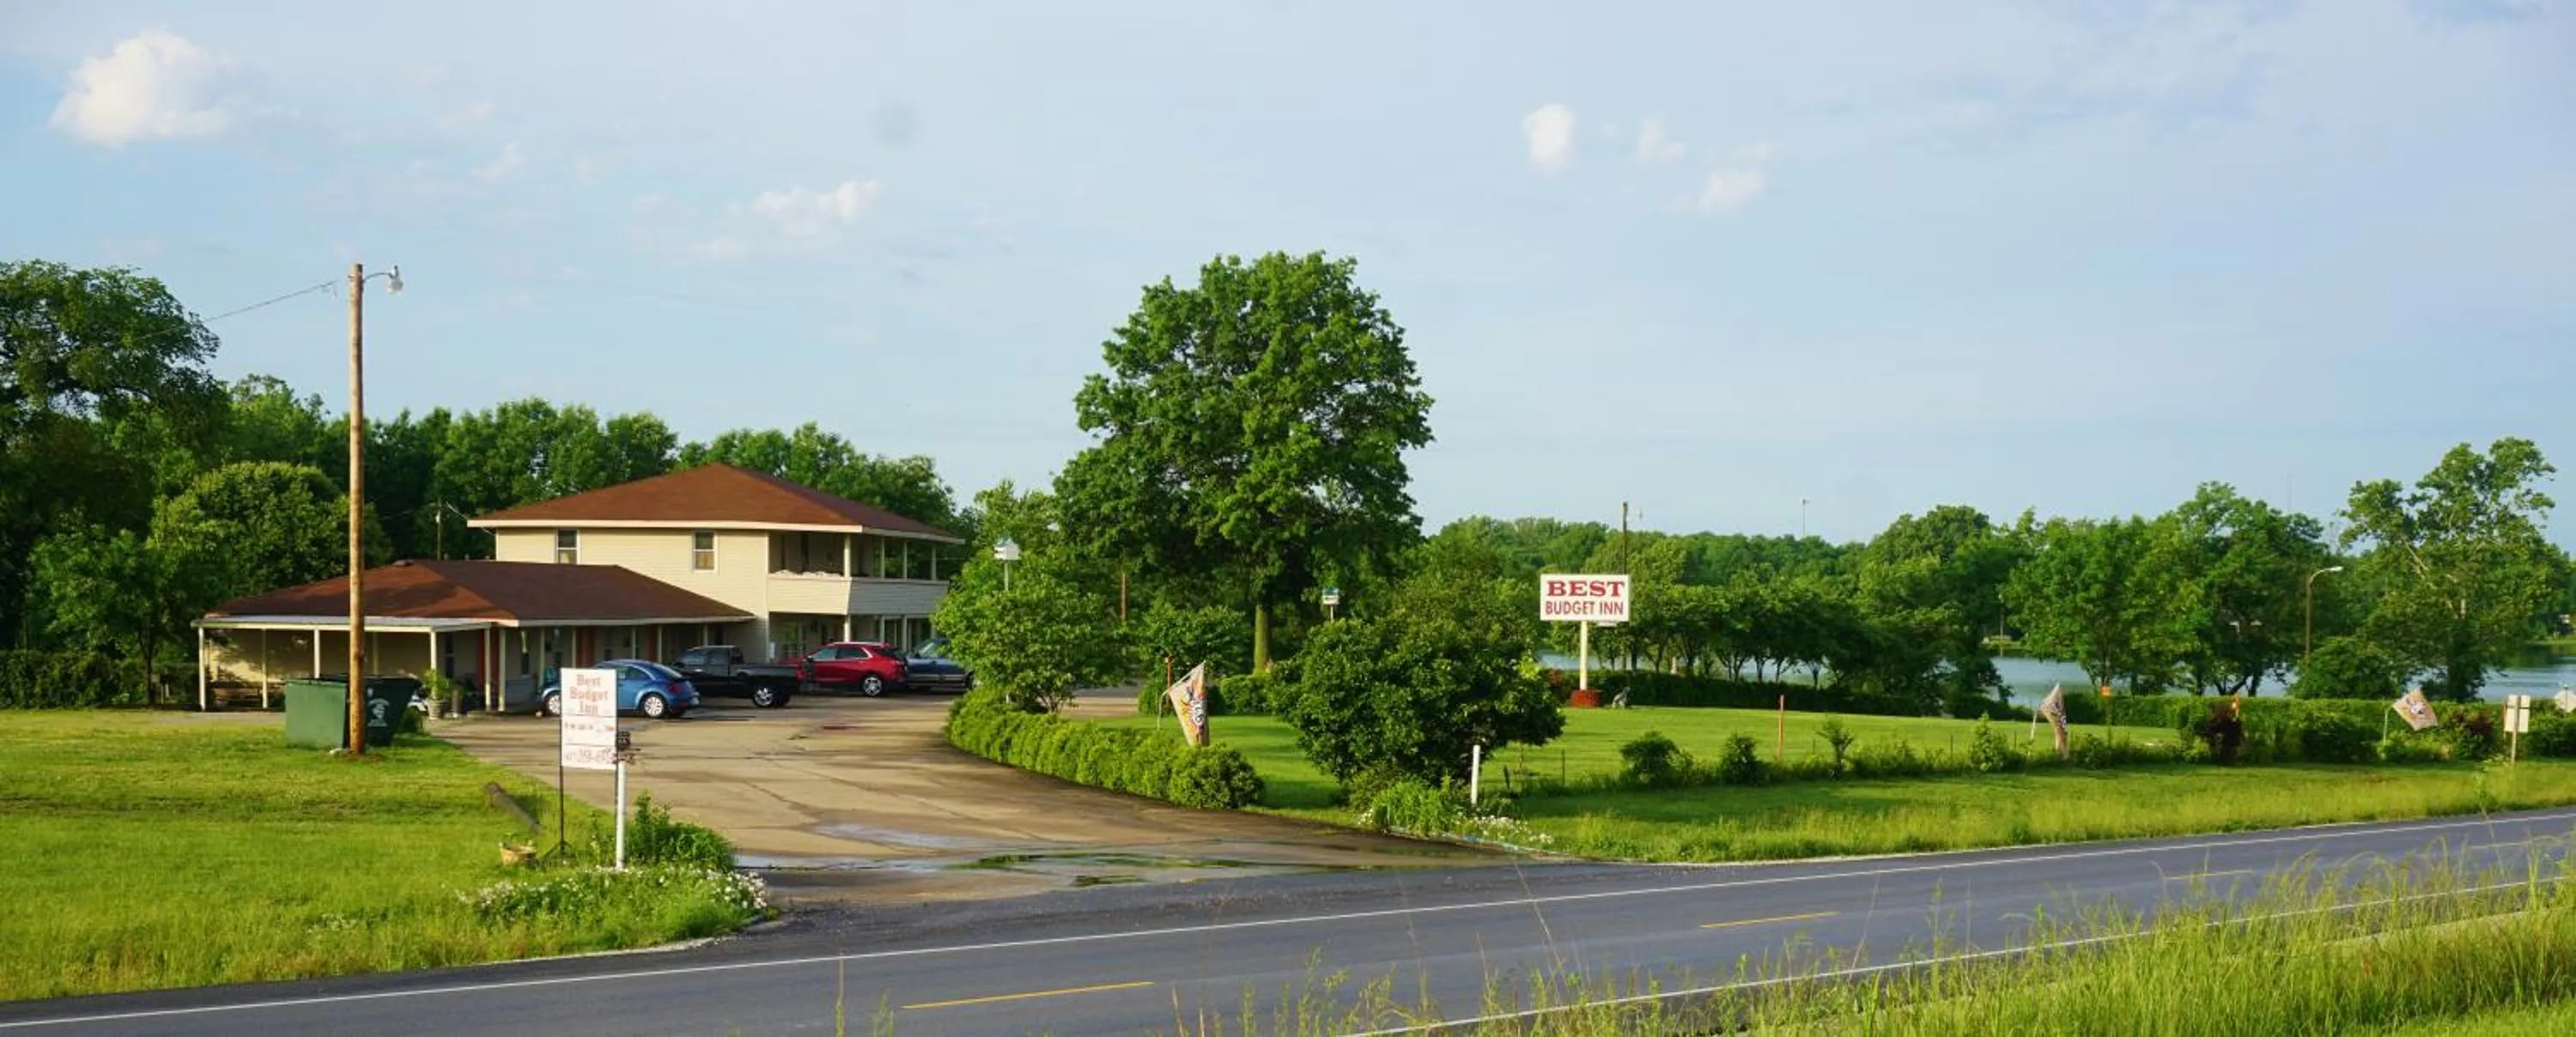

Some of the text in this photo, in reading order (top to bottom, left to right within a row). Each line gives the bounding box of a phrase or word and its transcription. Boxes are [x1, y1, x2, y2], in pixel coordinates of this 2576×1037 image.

[1547, 580, 1625, 597] BEST
[1546, 601, 1624, 616] BUDGET INN
[576, 674, 601, 687] Best
[569, 687, 608, 702] Budget
[579, 700, 598, 714] Inn
